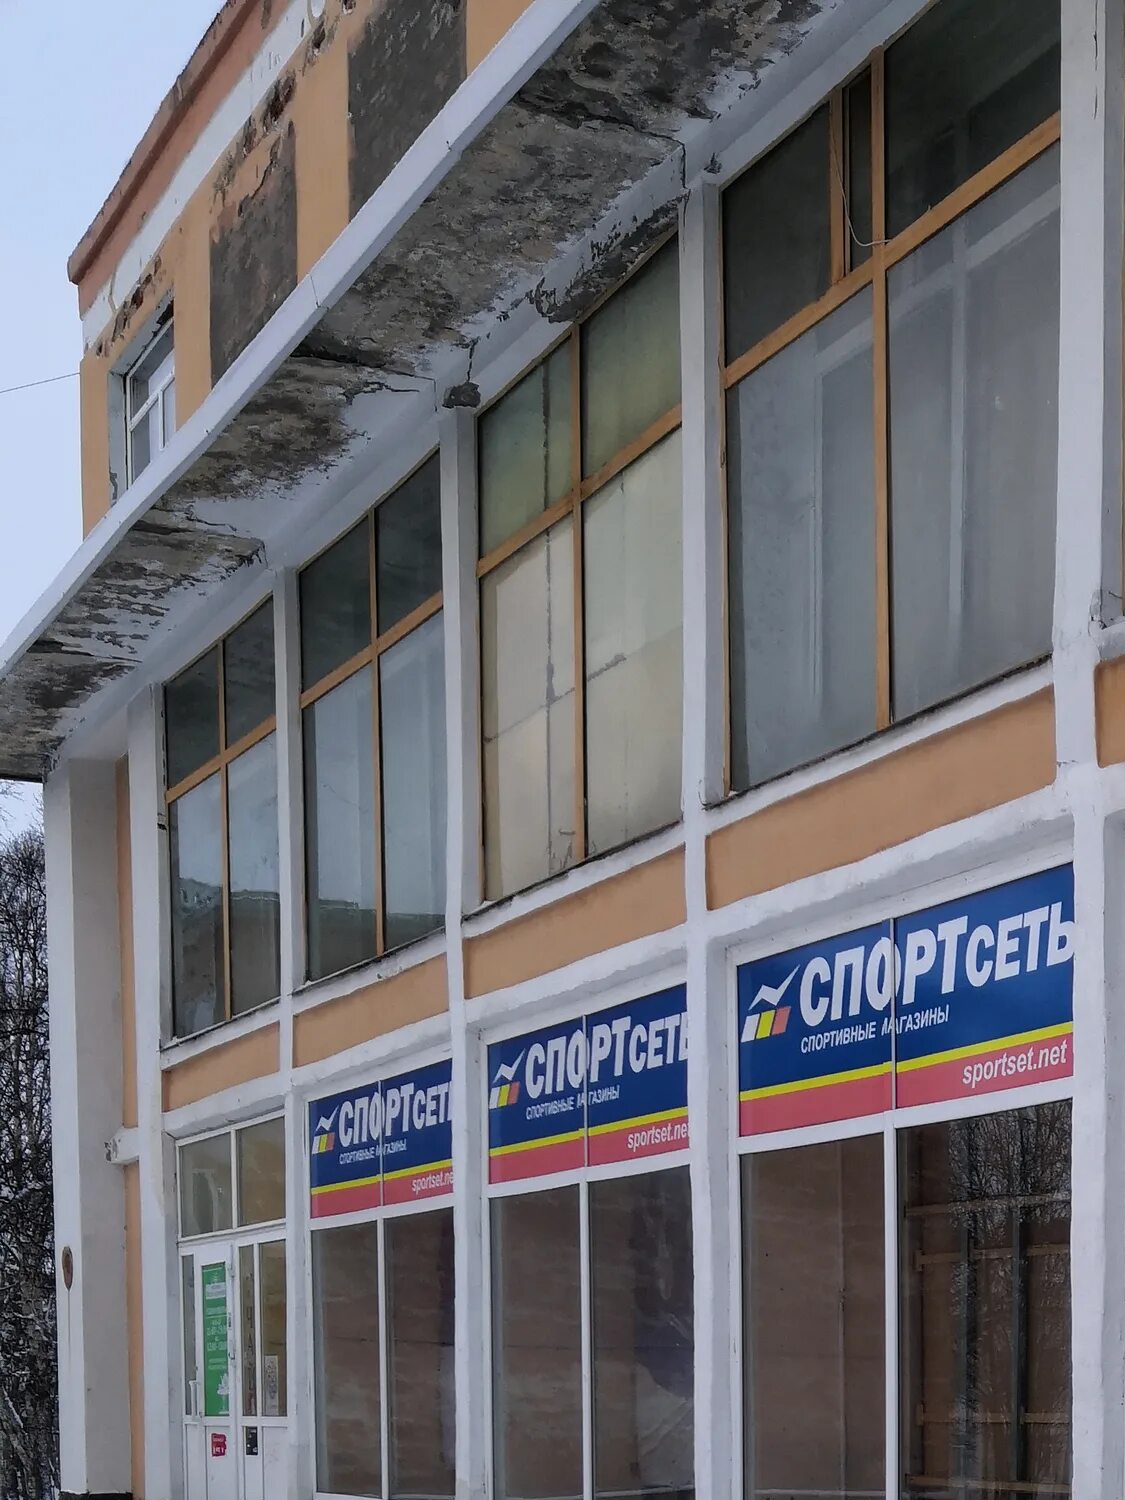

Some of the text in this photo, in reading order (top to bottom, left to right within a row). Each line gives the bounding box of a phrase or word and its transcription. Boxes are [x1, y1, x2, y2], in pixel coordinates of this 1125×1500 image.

[800, 1020, 876, 1054] СПОРТИВНЫЕ
[961, 1040, 1067, 1089] sportset.net
[525, 1096, 574, 1120] СПОРТИВНЫЕ
